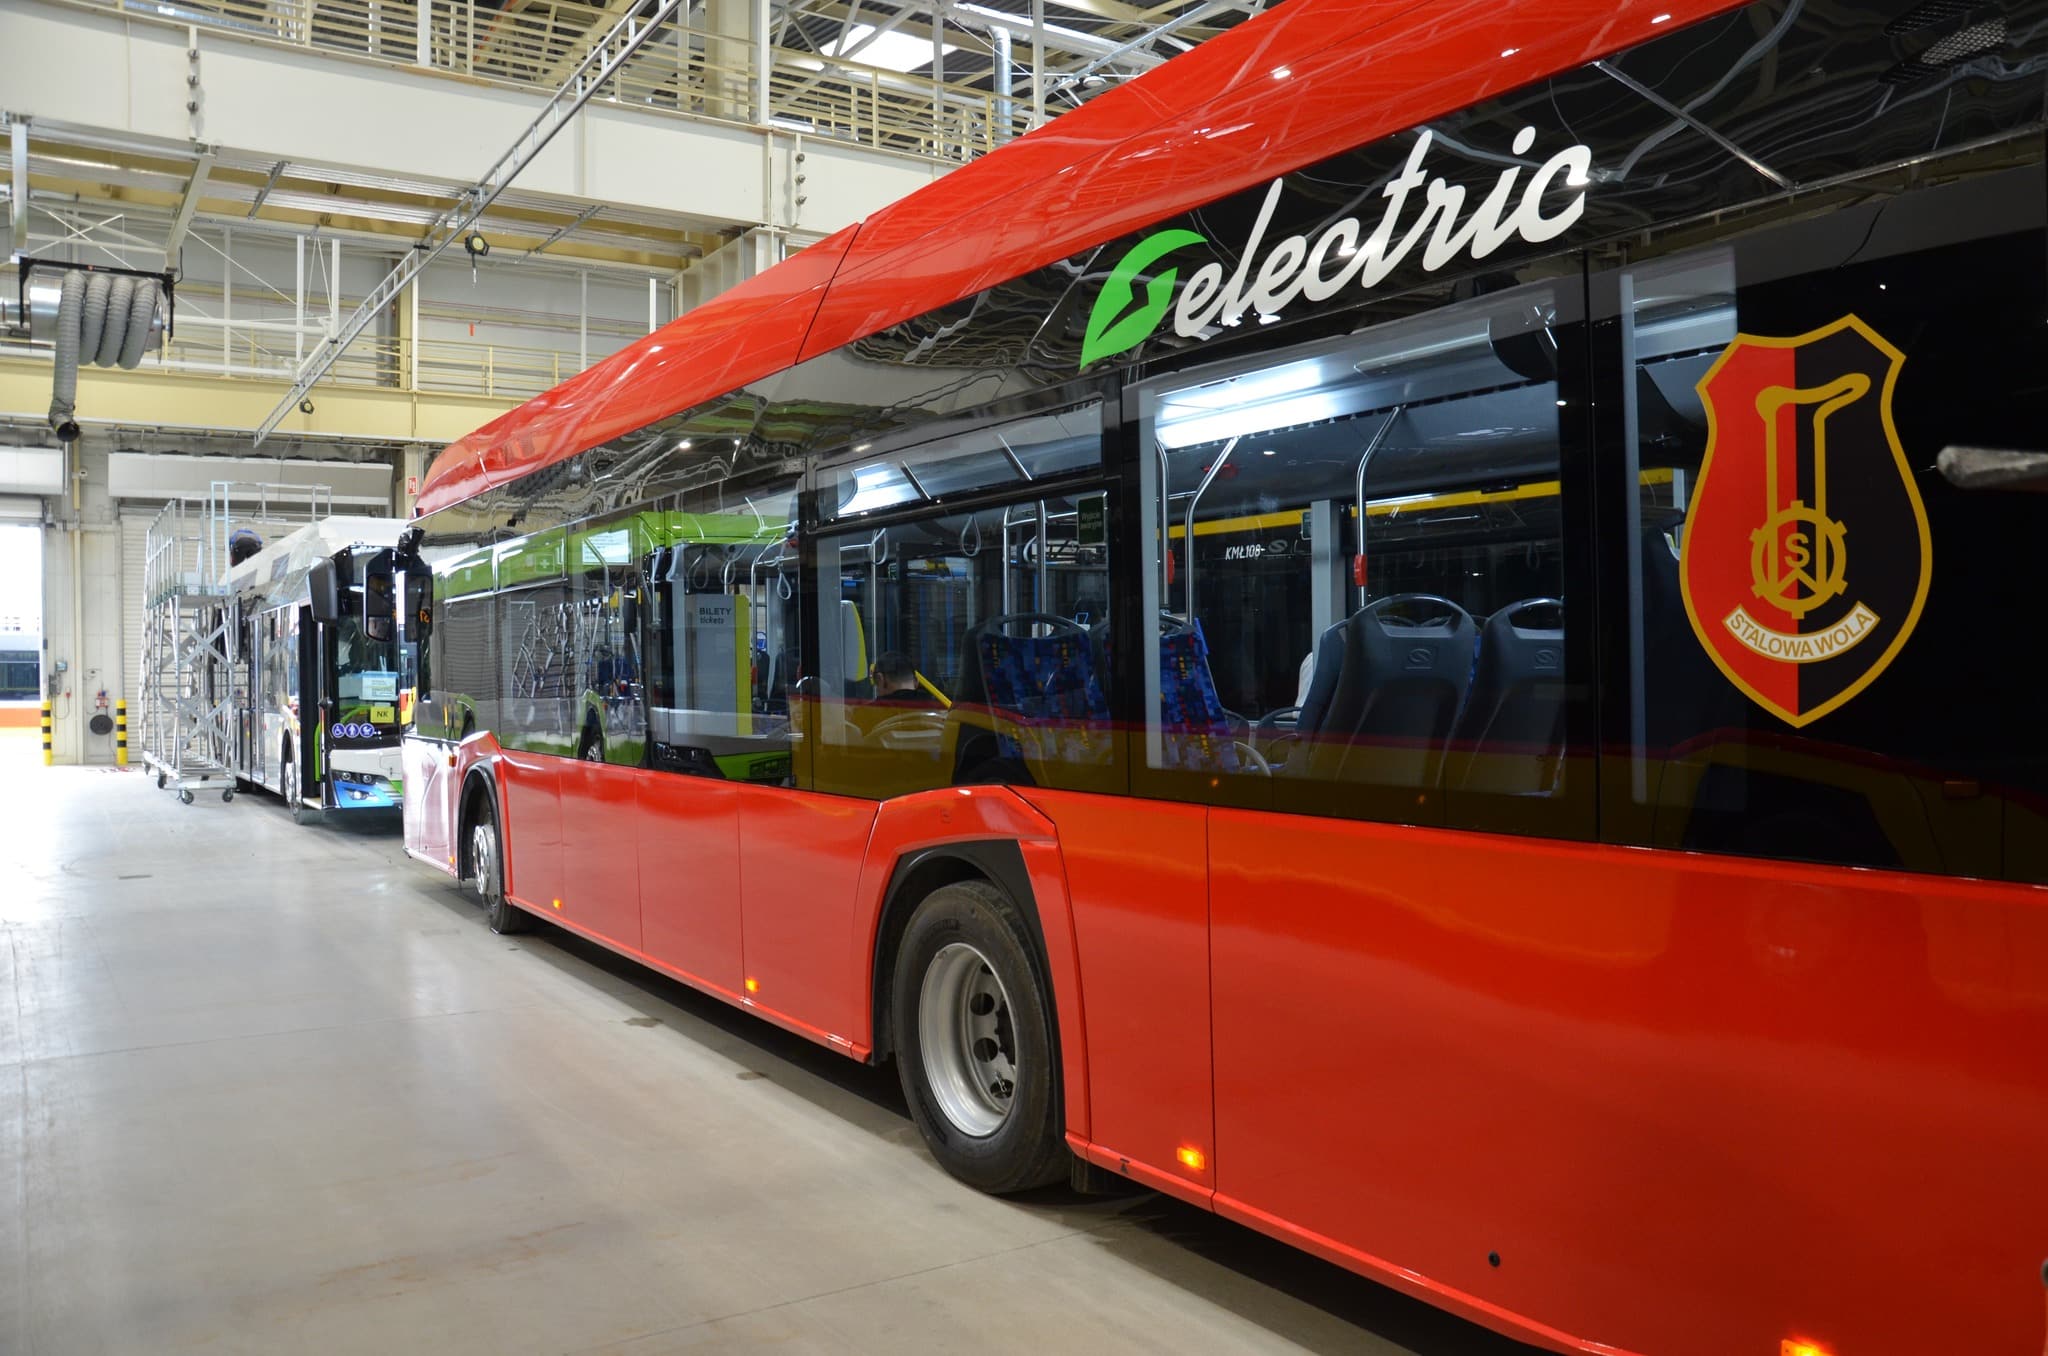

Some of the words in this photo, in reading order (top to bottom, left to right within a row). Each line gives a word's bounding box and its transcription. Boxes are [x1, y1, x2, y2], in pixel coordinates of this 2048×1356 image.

[1174, 126, 1592, 338] electric
[699, 607, 732, 616] BILETY
[699, 616, 725, 624] tickets
[1730, 613, 1814, 657] STALOWA
[1815, 612, 1873, 654] WOLA
